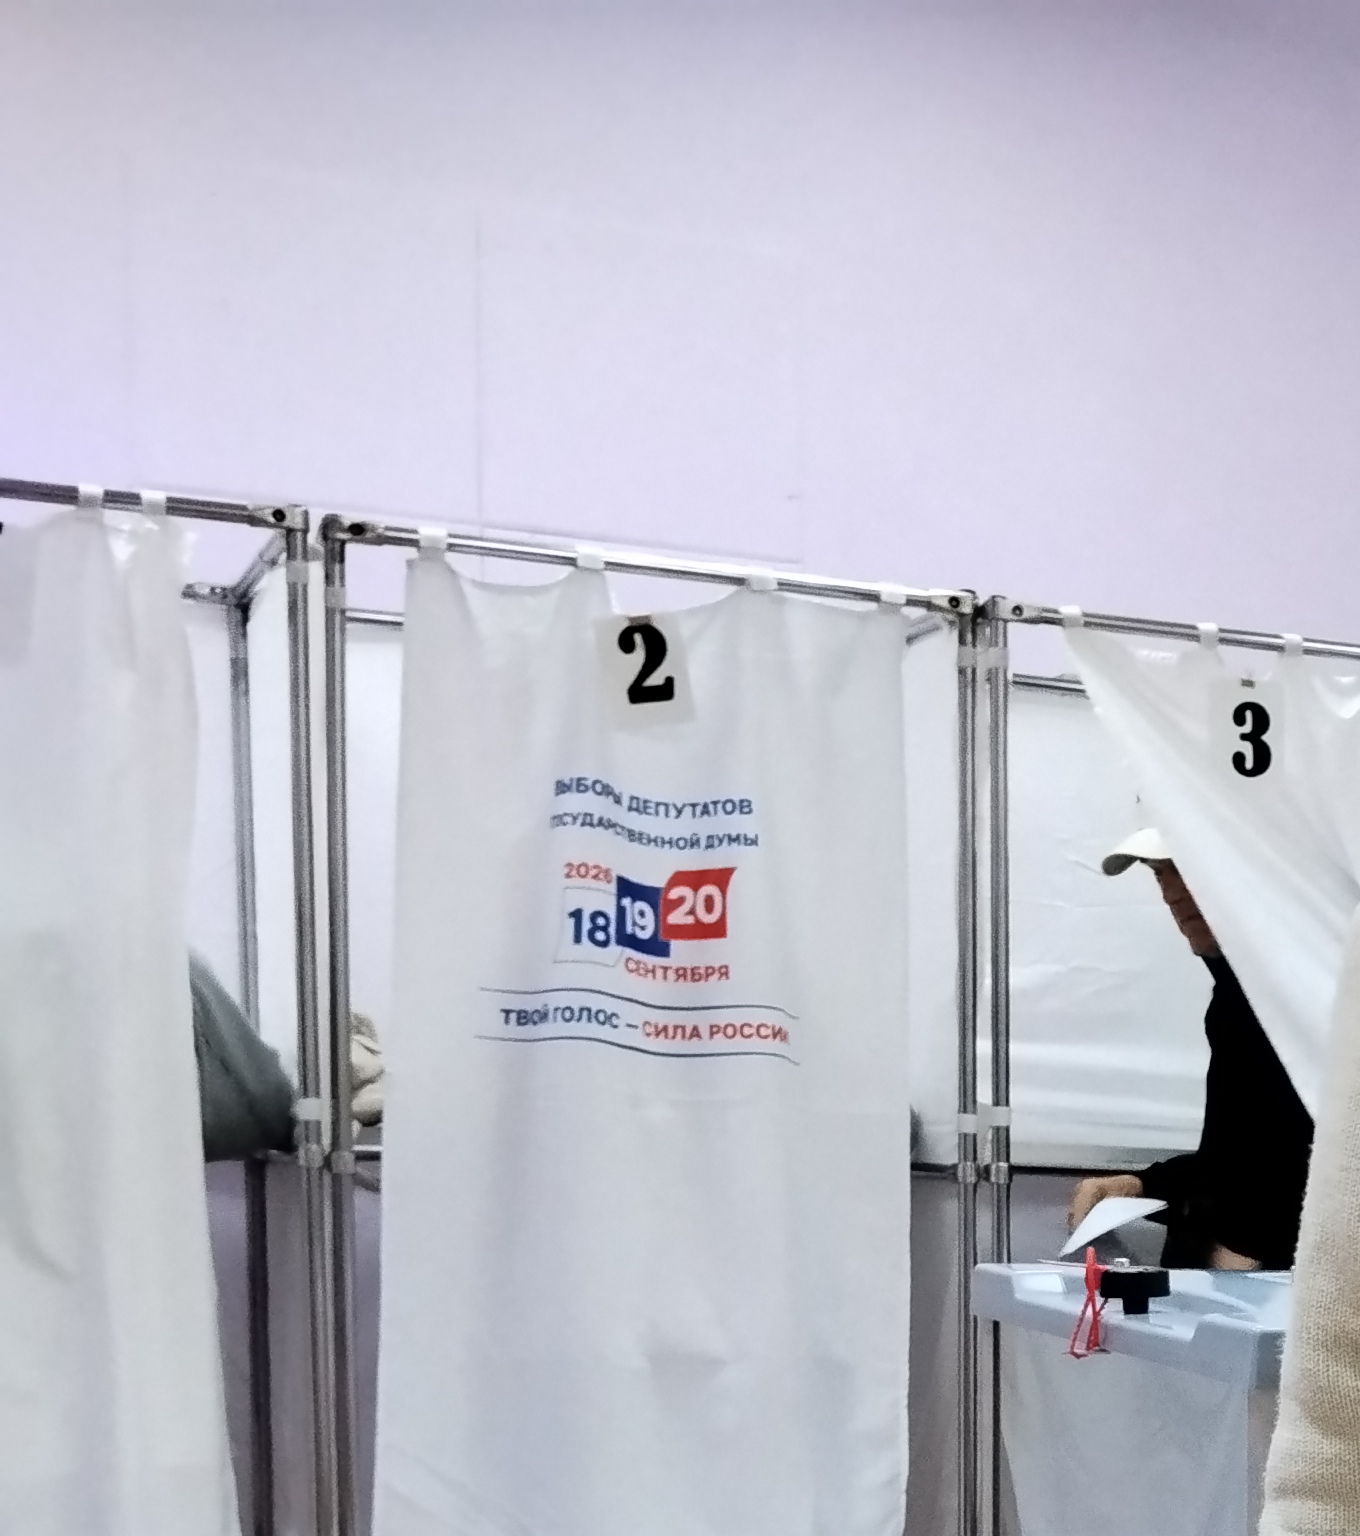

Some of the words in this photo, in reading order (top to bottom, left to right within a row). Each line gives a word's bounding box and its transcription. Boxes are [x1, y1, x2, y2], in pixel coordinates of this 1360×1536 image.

[618, 624, 674, 704] 2
[1232, 701, 1271, 777] 3
[627, 795, 754, 819] ДЕПУТАТОВ
[704, 833, 759, 851] ДУМЫ
[567, 908, 611, 948] 18
[620, 896, 655, 940] 19
[667, 884, 723, 925] 20
[625, 956, 730, 982] СЕНТЯБРЯ
[552, 1005, 620, 1029] ГОЛОС
[642, 1020, 702, 1041] СИЛА
